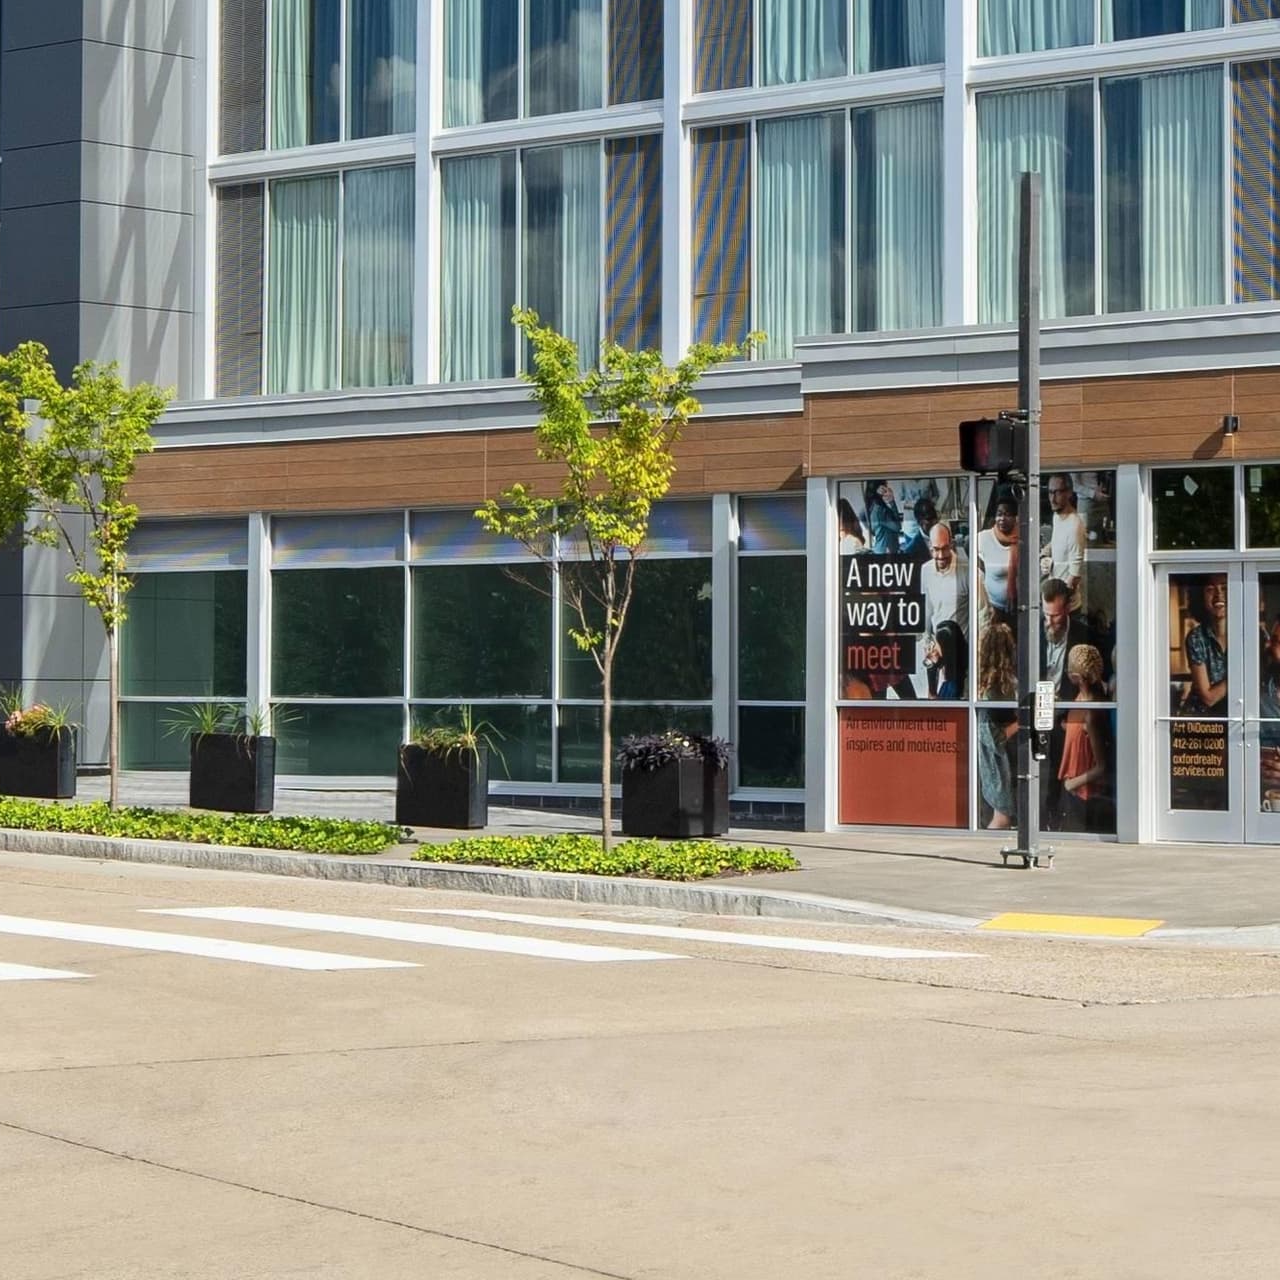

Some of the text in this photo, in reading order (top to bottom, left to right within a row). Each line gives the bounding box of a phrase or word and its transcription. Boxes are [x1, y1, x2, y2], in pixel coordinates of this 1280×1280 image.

[846, 557, 914, 588] A new
[846, 597, 920, 631] way to
[847, 642, 901, 670] meet
[846, 716, 948, 732] An environment that
[846, 737, 885, 753] inspires
[886, 739, 905, 752] and
